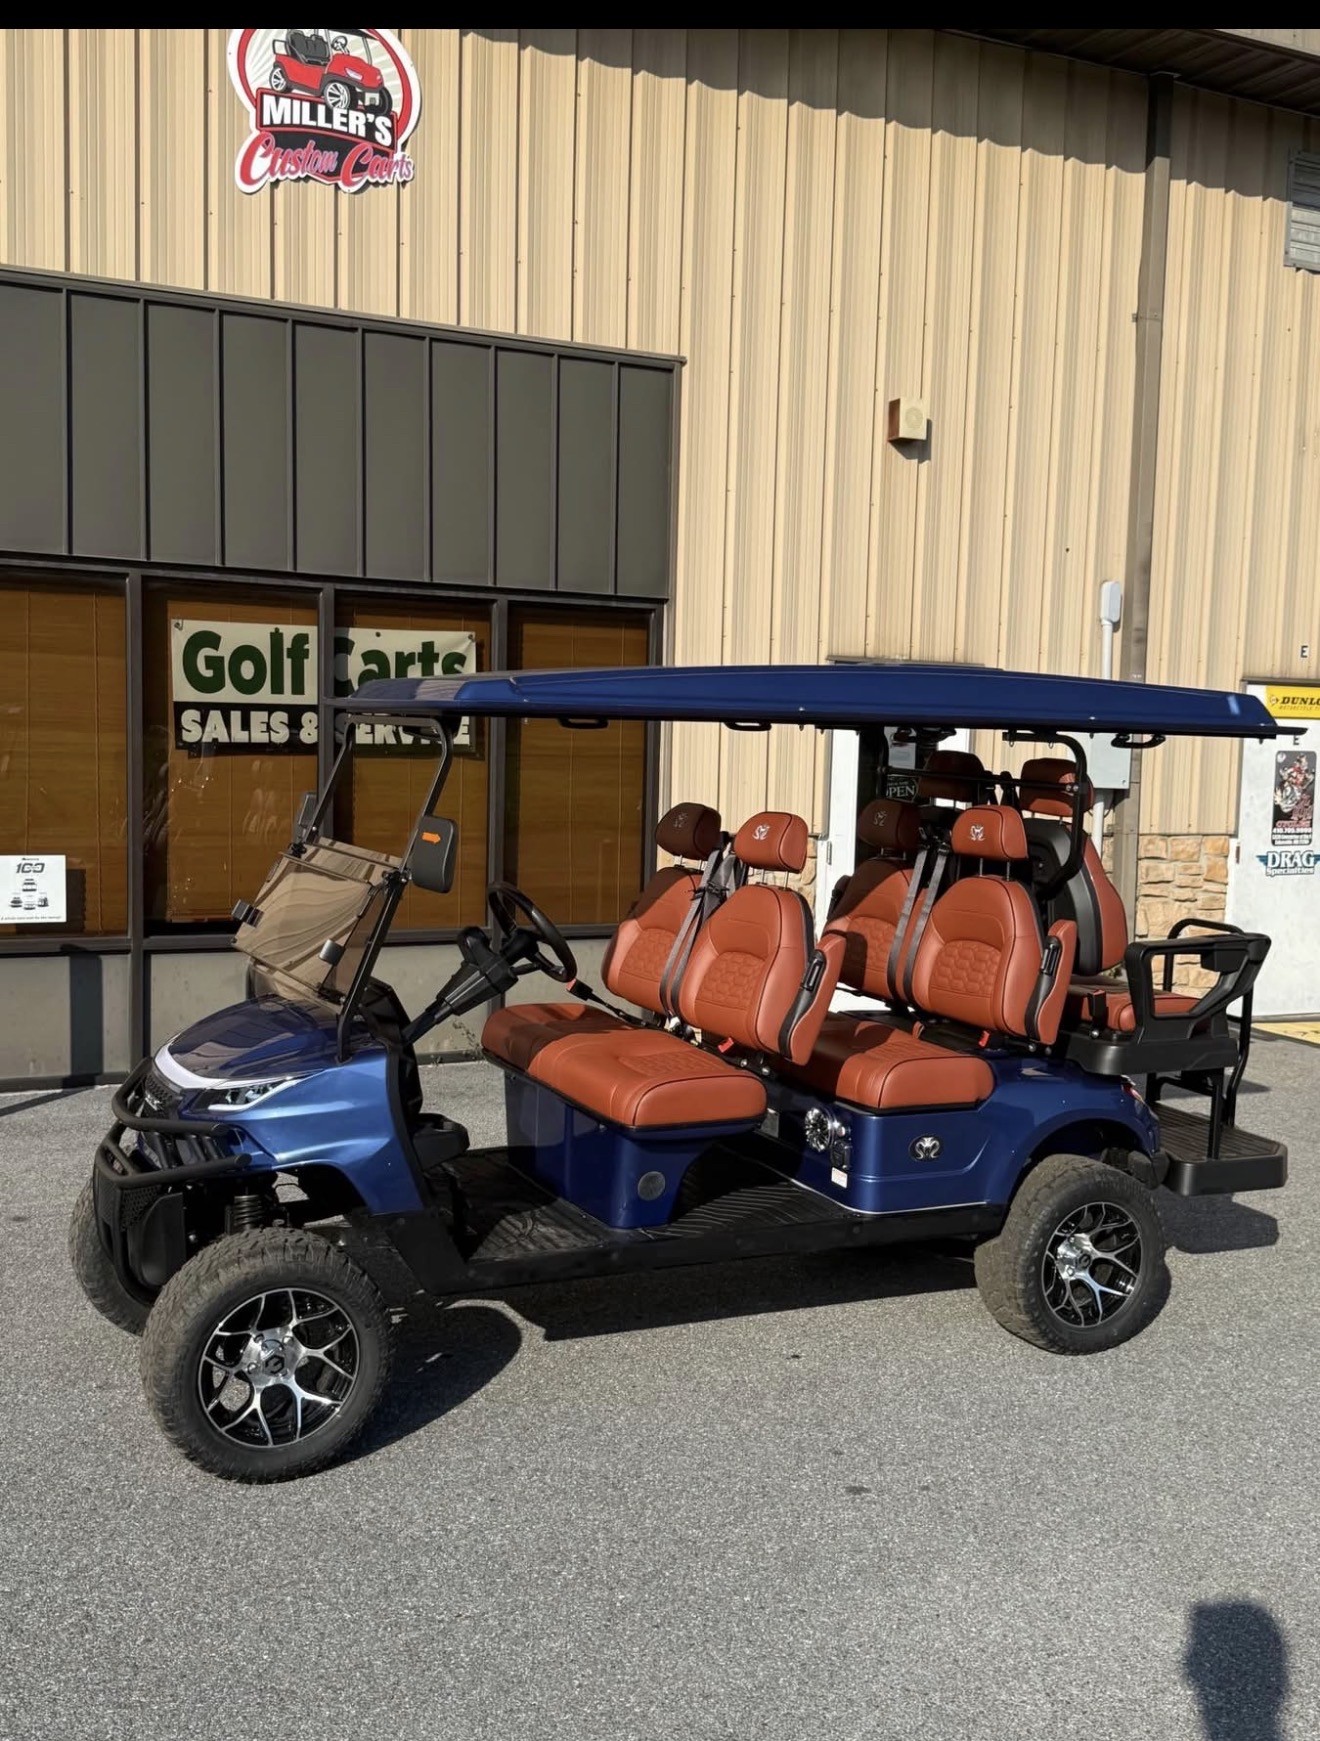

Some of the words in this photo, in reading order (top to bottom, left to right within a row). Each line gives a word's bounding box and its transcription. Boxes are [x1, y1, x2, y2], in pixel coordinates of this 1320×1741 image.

[262, 93, 392, 147] MILLER'S
[239, 131, 339, 185] Custom
[340, 141, 415, 187] Carts
[182, 630, 310, 696] Golf
[180, 708, 291, 744] SALES
[299, 709, 318, 745] &
[885, 785, 915, 798] PEN
[1266, 850, 1315, 868] DRAG
